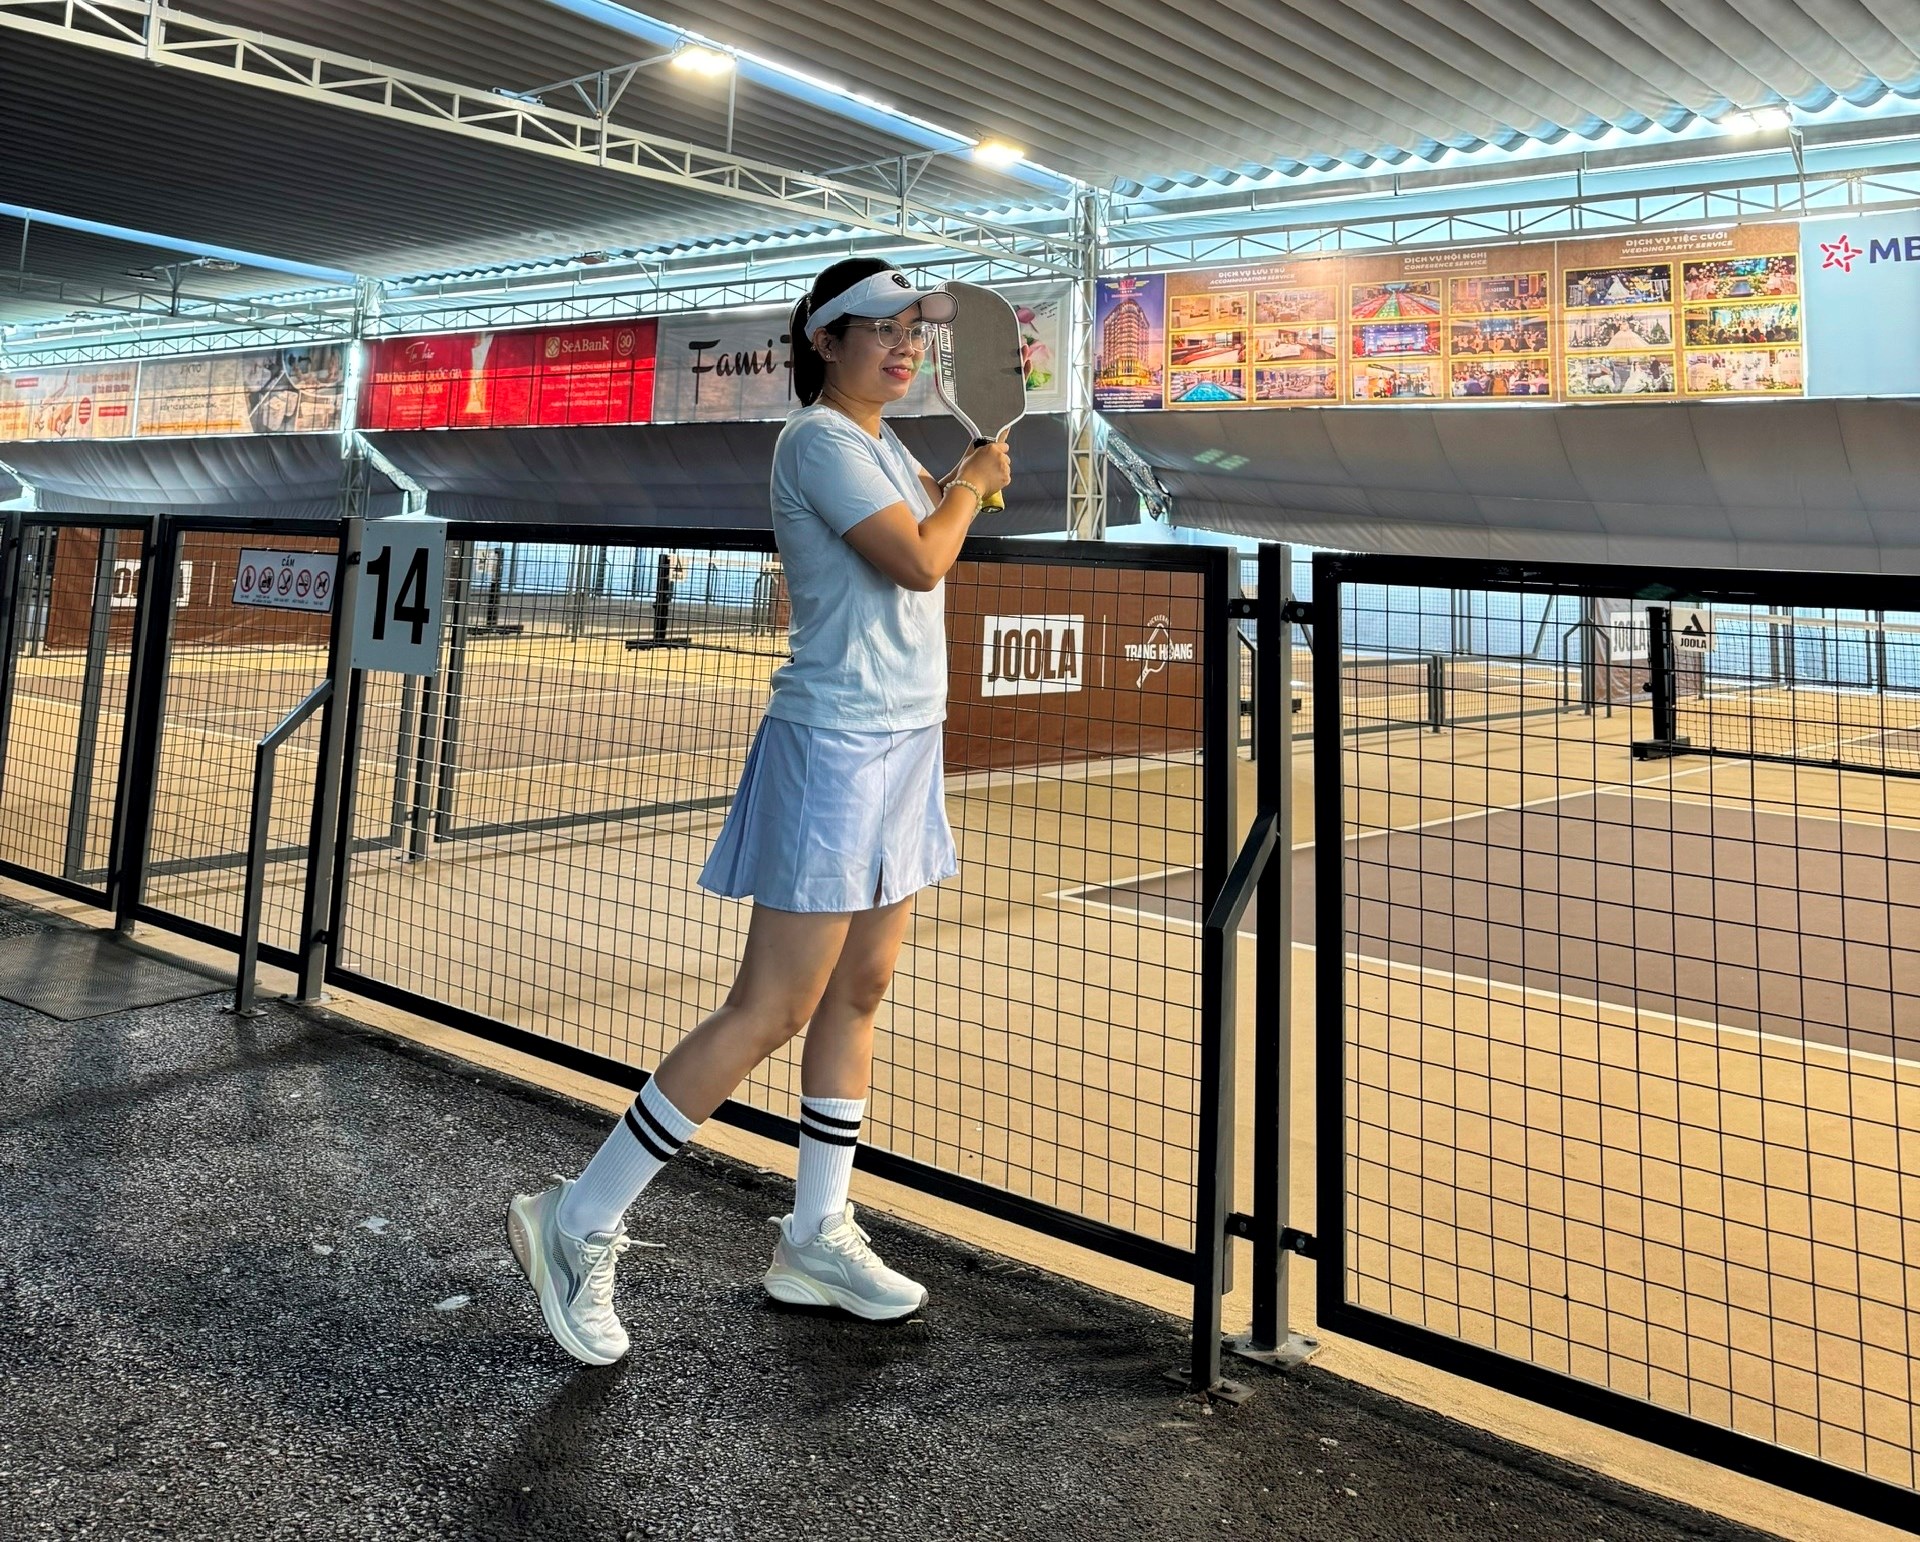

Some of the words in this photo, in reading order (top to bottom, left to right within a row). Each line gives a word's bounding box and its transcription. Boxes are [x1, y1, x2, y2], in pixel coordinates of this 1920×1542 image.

[1621, 245, 1664, 255] WEDDING
[1665, 243, 1696, 251] PARTY
[1696, 240, 1734, 249] SERVICE
[1404, 261, 1454, 270] CONFERENCE
[561, 336, 610, 353] SeABank
[619, 334, 633, 349] 30
[688, 338, 777, 405] Fami
[281, 554, 295, 567] CẤM
[366, 545, 431, 645] 14
[1613, 620, 1646, 653] JOOLA
[1679, 637, 1707, 649] JOOLA
[987, 628, 1077, 683] JOOLA
[1124, 644, 1157, 661] TRANG
